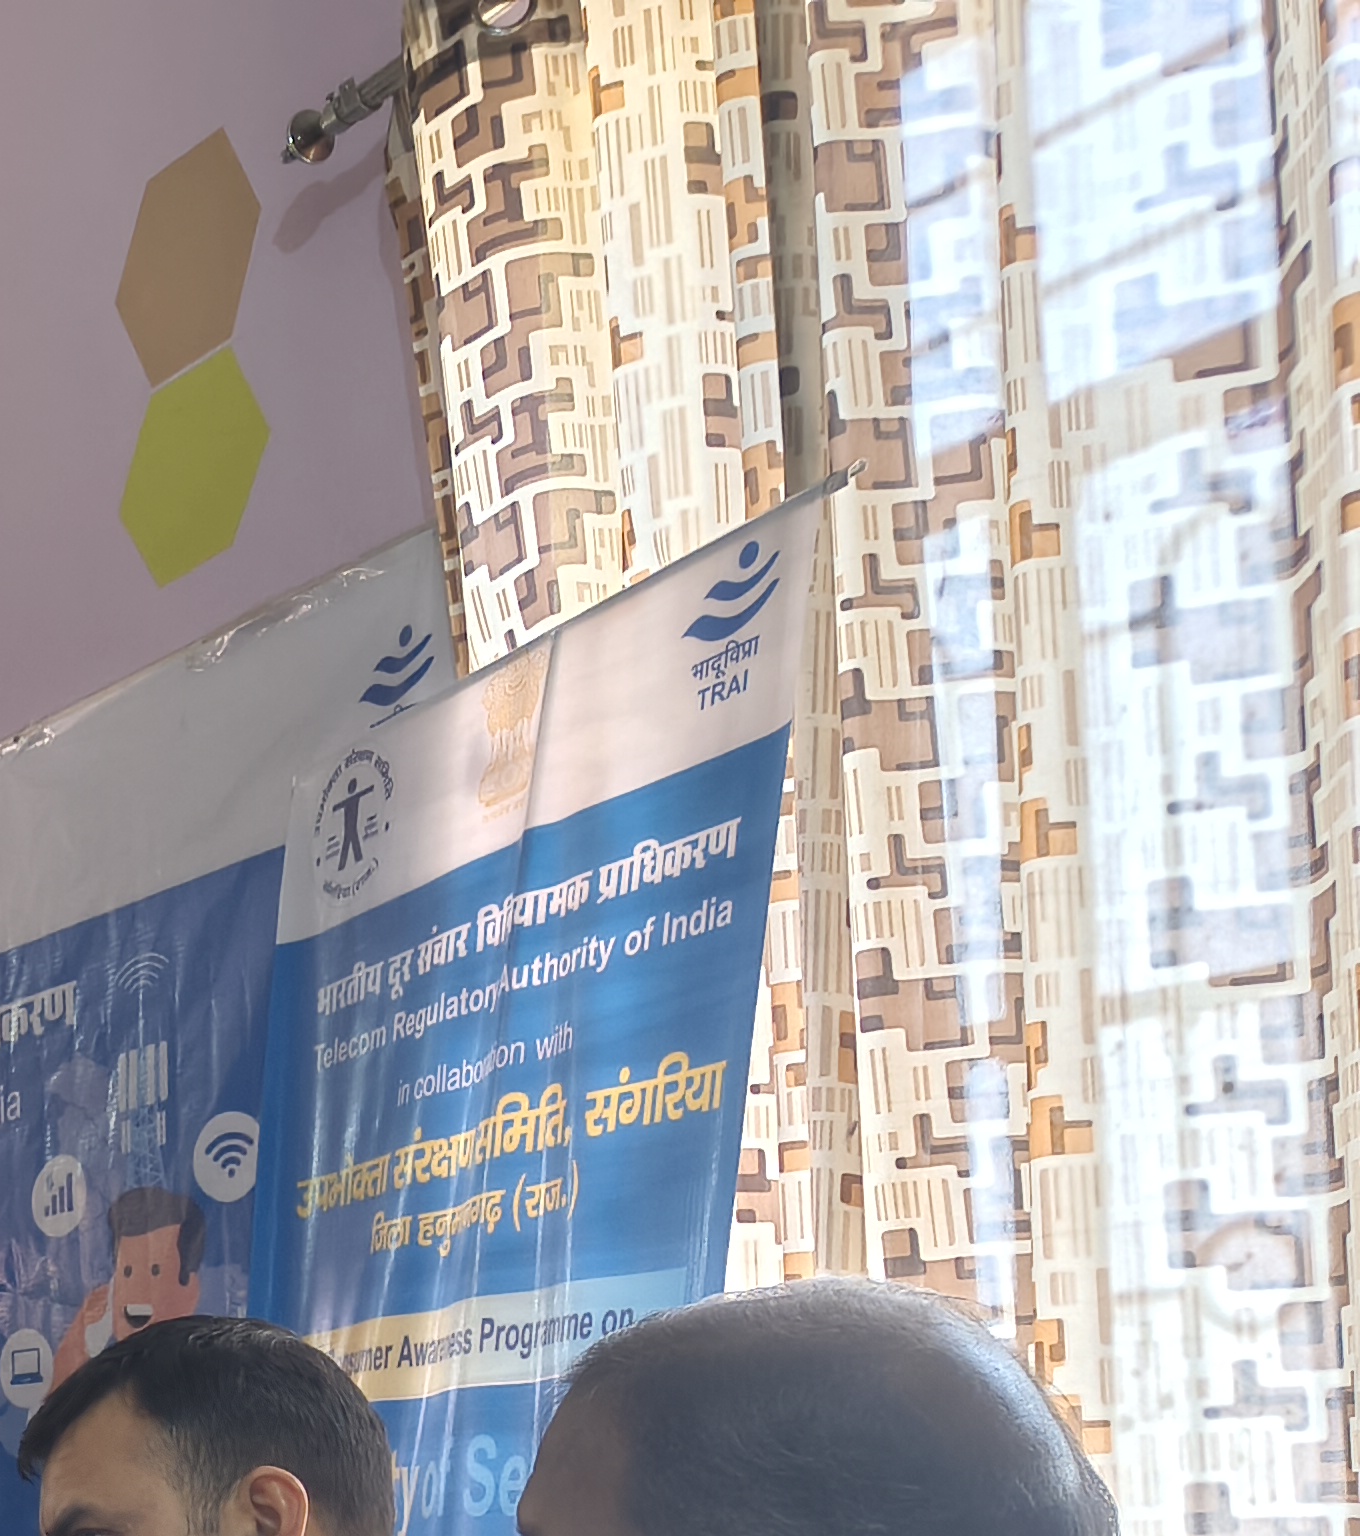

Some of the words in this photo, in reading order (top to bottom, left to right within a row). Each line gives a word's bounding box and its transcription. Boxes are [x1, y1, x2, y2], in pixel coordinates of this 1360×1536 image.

[690, 635, 761, 684] भादूविप्रा
[697, 670, 749, 711] TRAI
[317, 959, 384, 1017] भारतीय
[387, 944, 414, 1000] दूर
[417, 924, 470, 973] संचार
[475, 870, 593, 952] विनियामक
[596, 816, 742, 905] प्राधिकरण
[314, 1019, 387, 1074] Telecom
[393, 980, 498, 1043] Regulatory
[497, 935, 617, 996] Authority
[623, 917, 656, 956] of
[661, 897, 734, 944] India
[397, 1079, 411, 1107] in
[413, 1041, 526, 1102] collaboration
[536, 1021, 574, 1060] with
[296, 1149, 390, 1220] उपभोक्ता
[585, 1051, 727, 1137] संगरिया
[370, 1211, 412, 1255] जिला
[512, 1160, 580, 1232] (राज.)
[479, 1313, 592, 1360] Programme
[601, 1307, 634, 1337] on
